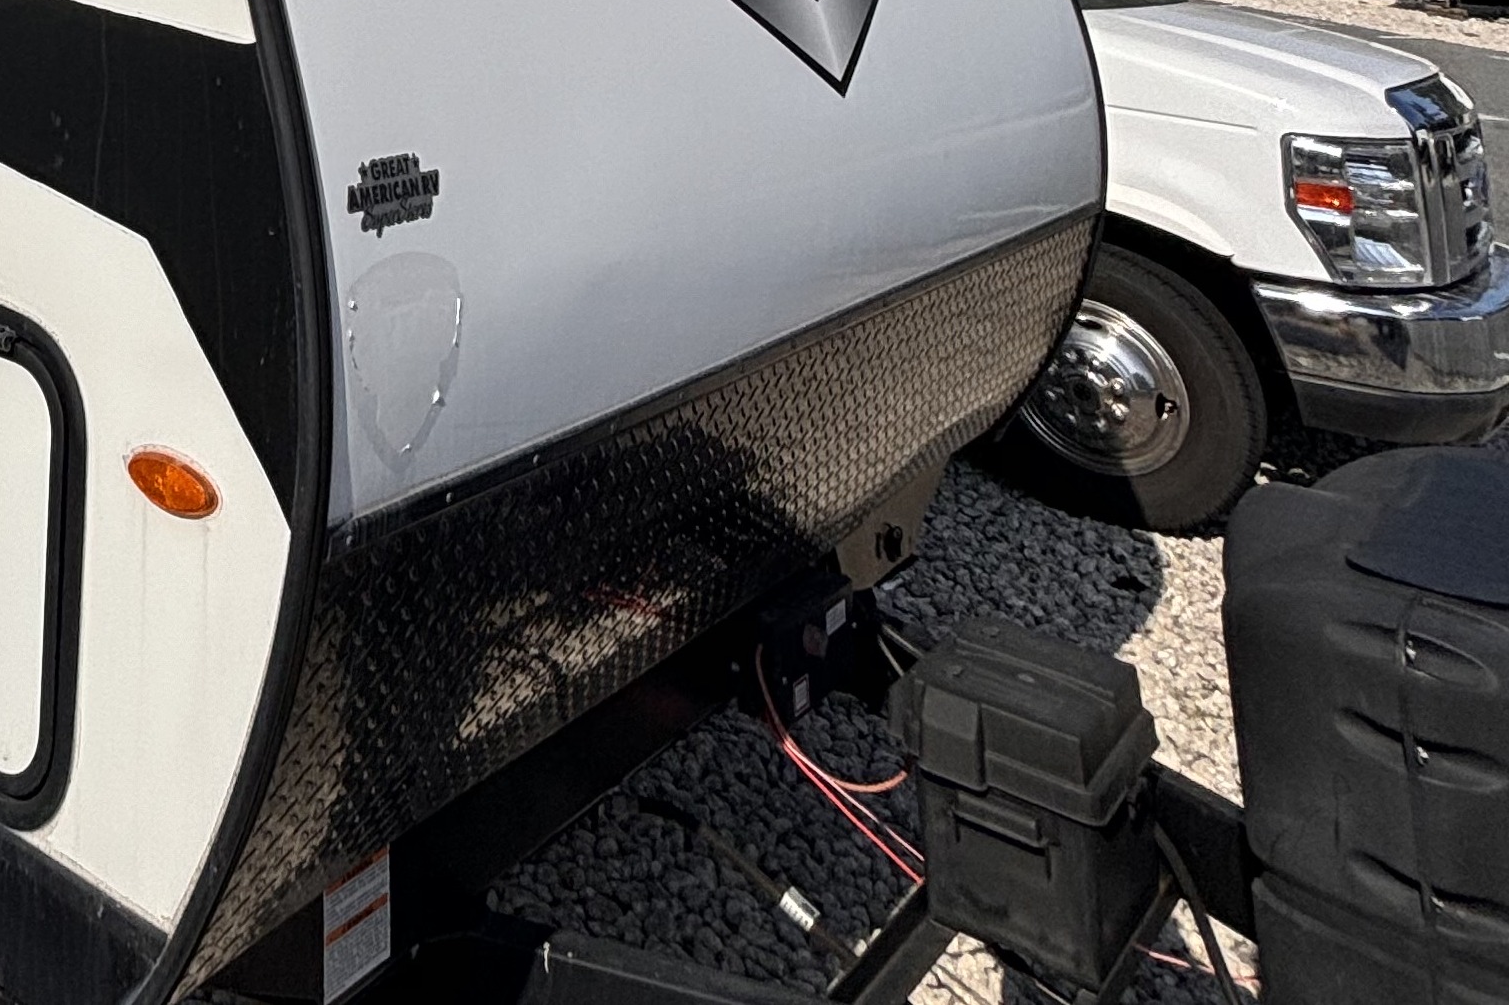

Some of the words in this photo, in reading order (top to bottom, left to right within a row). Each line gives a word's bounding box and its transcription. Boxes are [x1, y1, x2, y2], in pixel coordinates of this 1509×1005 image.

[370, 156, 410, 181] GREAT
[348, 176, 420, 211] AMERICAN
[420, 172, 439, 197] RV
